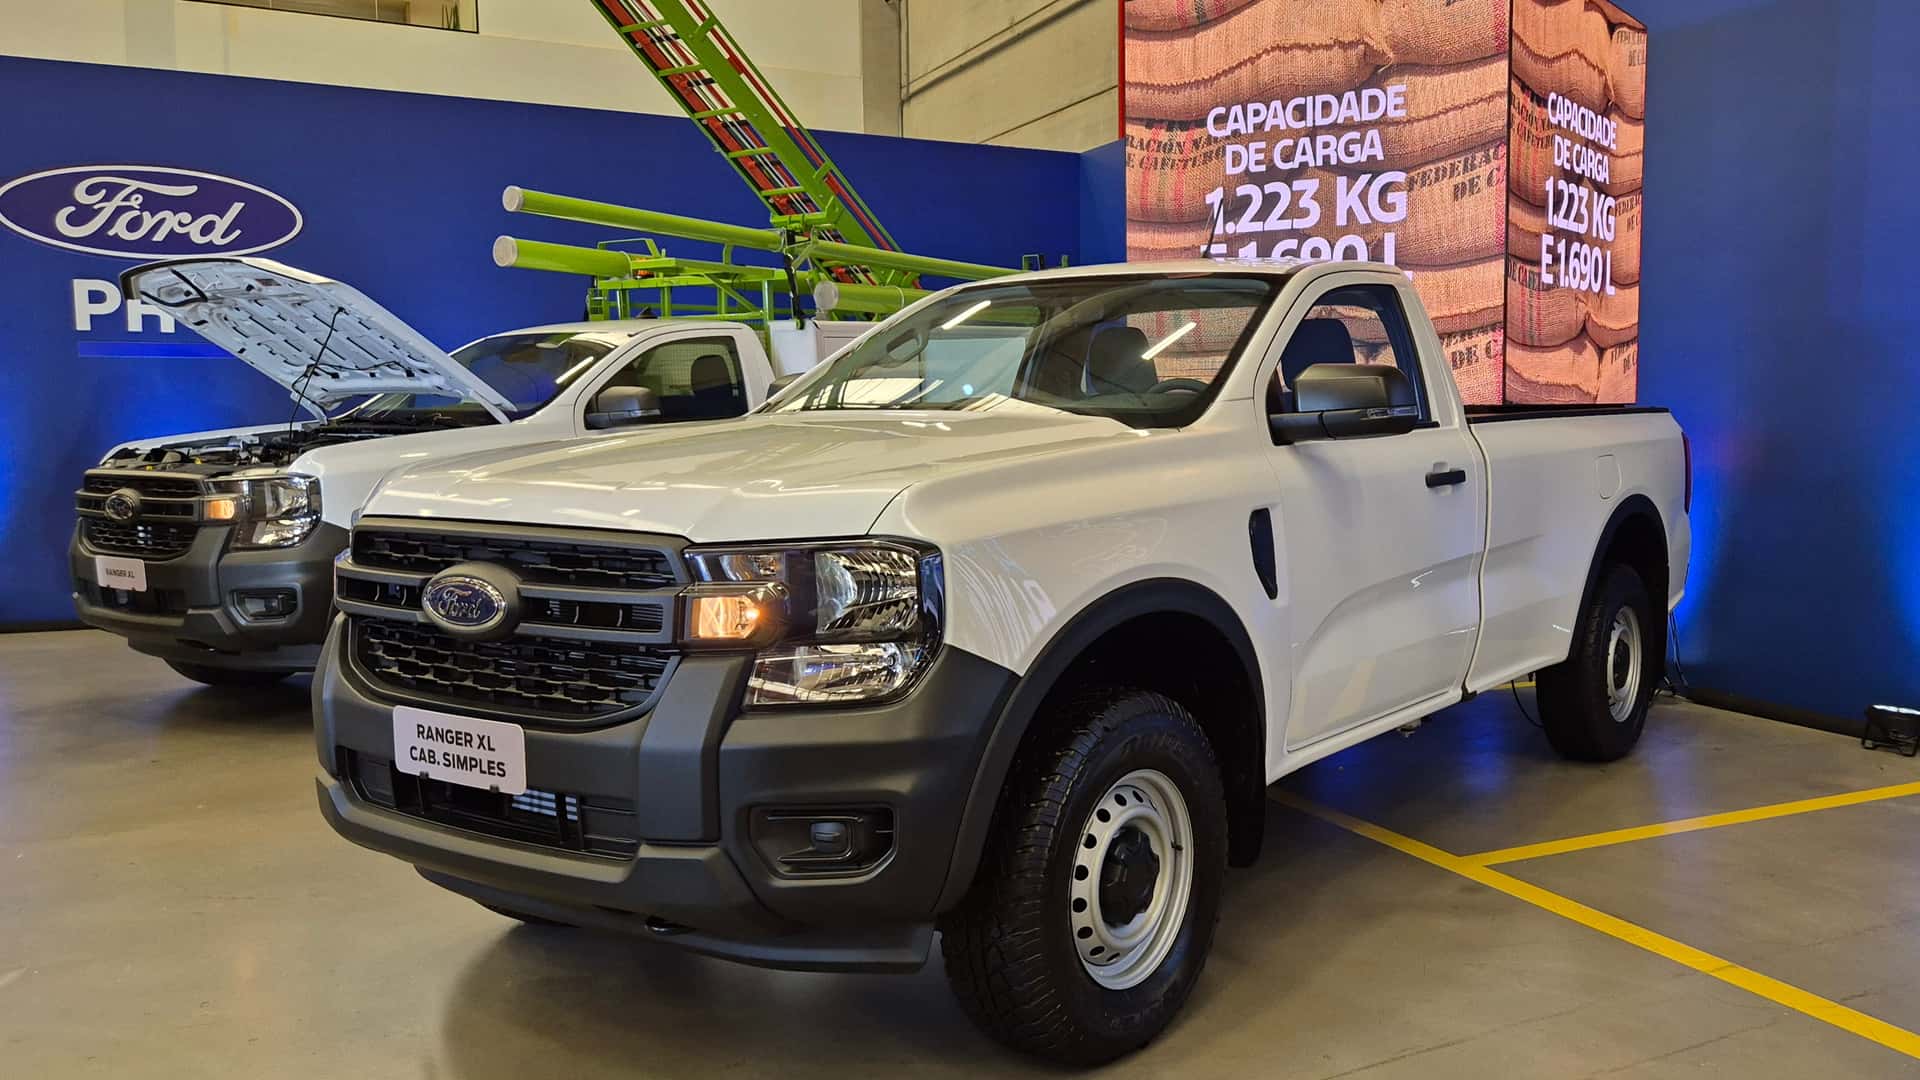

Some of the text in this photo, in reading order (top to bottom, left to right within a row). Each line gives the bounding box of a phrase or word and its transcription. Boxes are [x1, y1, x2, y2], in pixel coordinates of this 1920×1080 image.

[1206, 84, 1408, 138] CAPACIDADE
[1547, 91, 1617, 151] CAPACIDADE
[1225, 128, 1385, 175] DE CARGA
[1554, 134, 1610, 185] DE CARGA
[55, 176, 246, 246] Ford
[1205, 170, 1409, 236] 1.223 KG
[1545, 175, 1616, 242] 1.223 KG
[1541, 233, 1554, 285] E
[1557, 238, 1603, 293] 1.690
[1605, 250, 1616, 296] L
[438, 586, 482, 619] Ford
[409, 745, 506, 778] CAB. SIMPLES
[416, 723, 496, 752] RANGER XL
